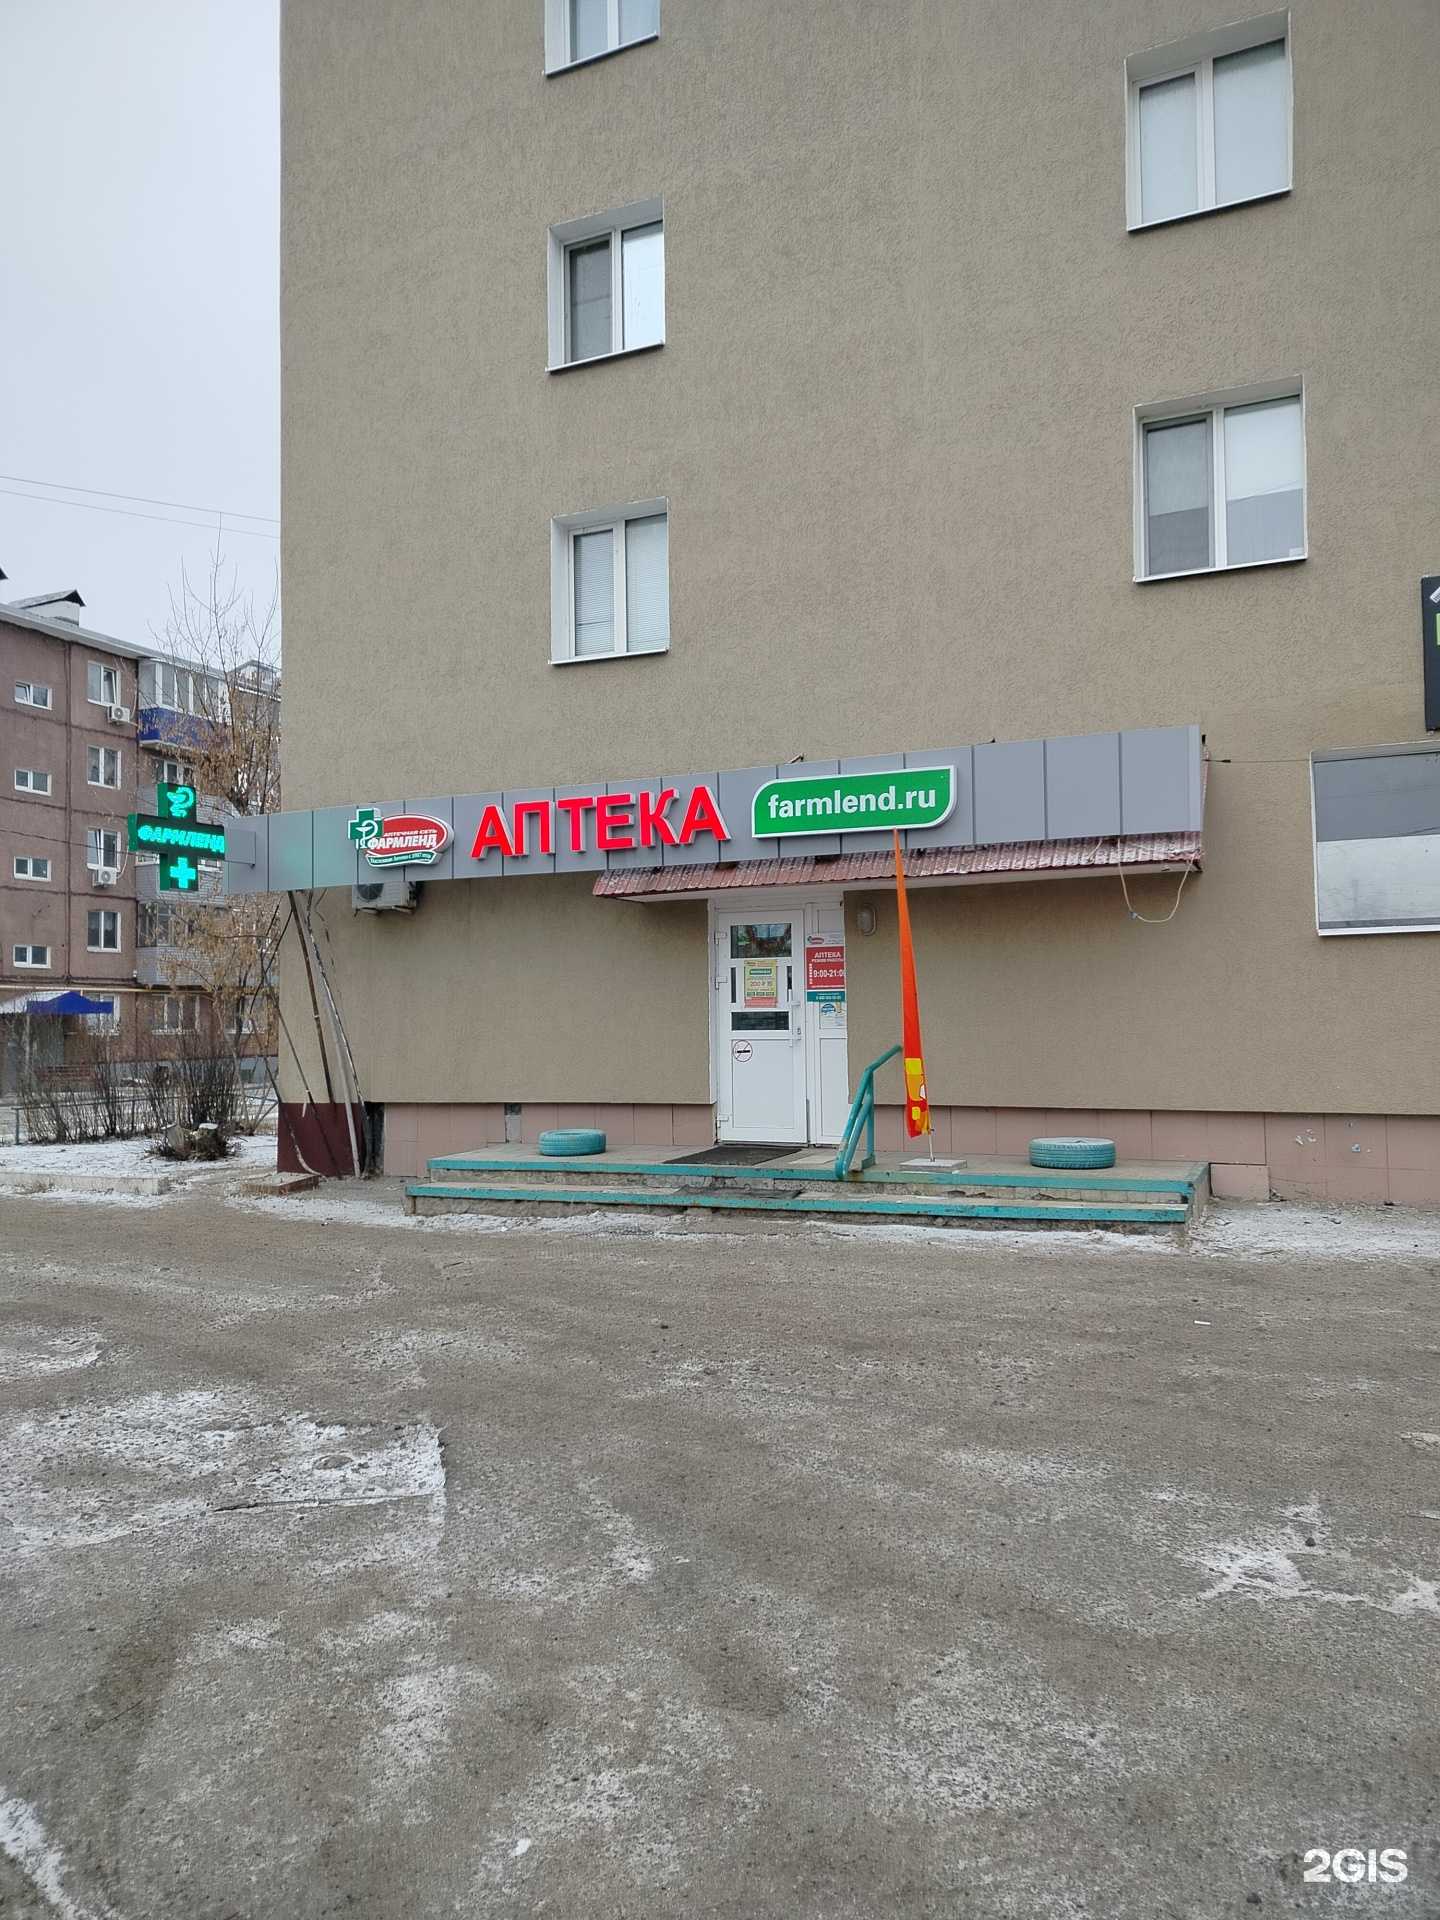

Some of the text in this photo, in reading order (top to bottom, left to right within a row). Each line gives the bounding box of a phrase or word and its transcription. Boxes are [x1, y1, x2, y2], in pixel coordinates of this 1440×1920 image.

[767, 785, 937, 819] farmlend.ru
[470, 785, 731, 860] АПТЕКА
[137, 824, 225, 853] ФАРМЛЕНД
[367, 834, 438, 850] ФАРМЛЕНД
[814, 951, 842, 959] АПТЕКА
